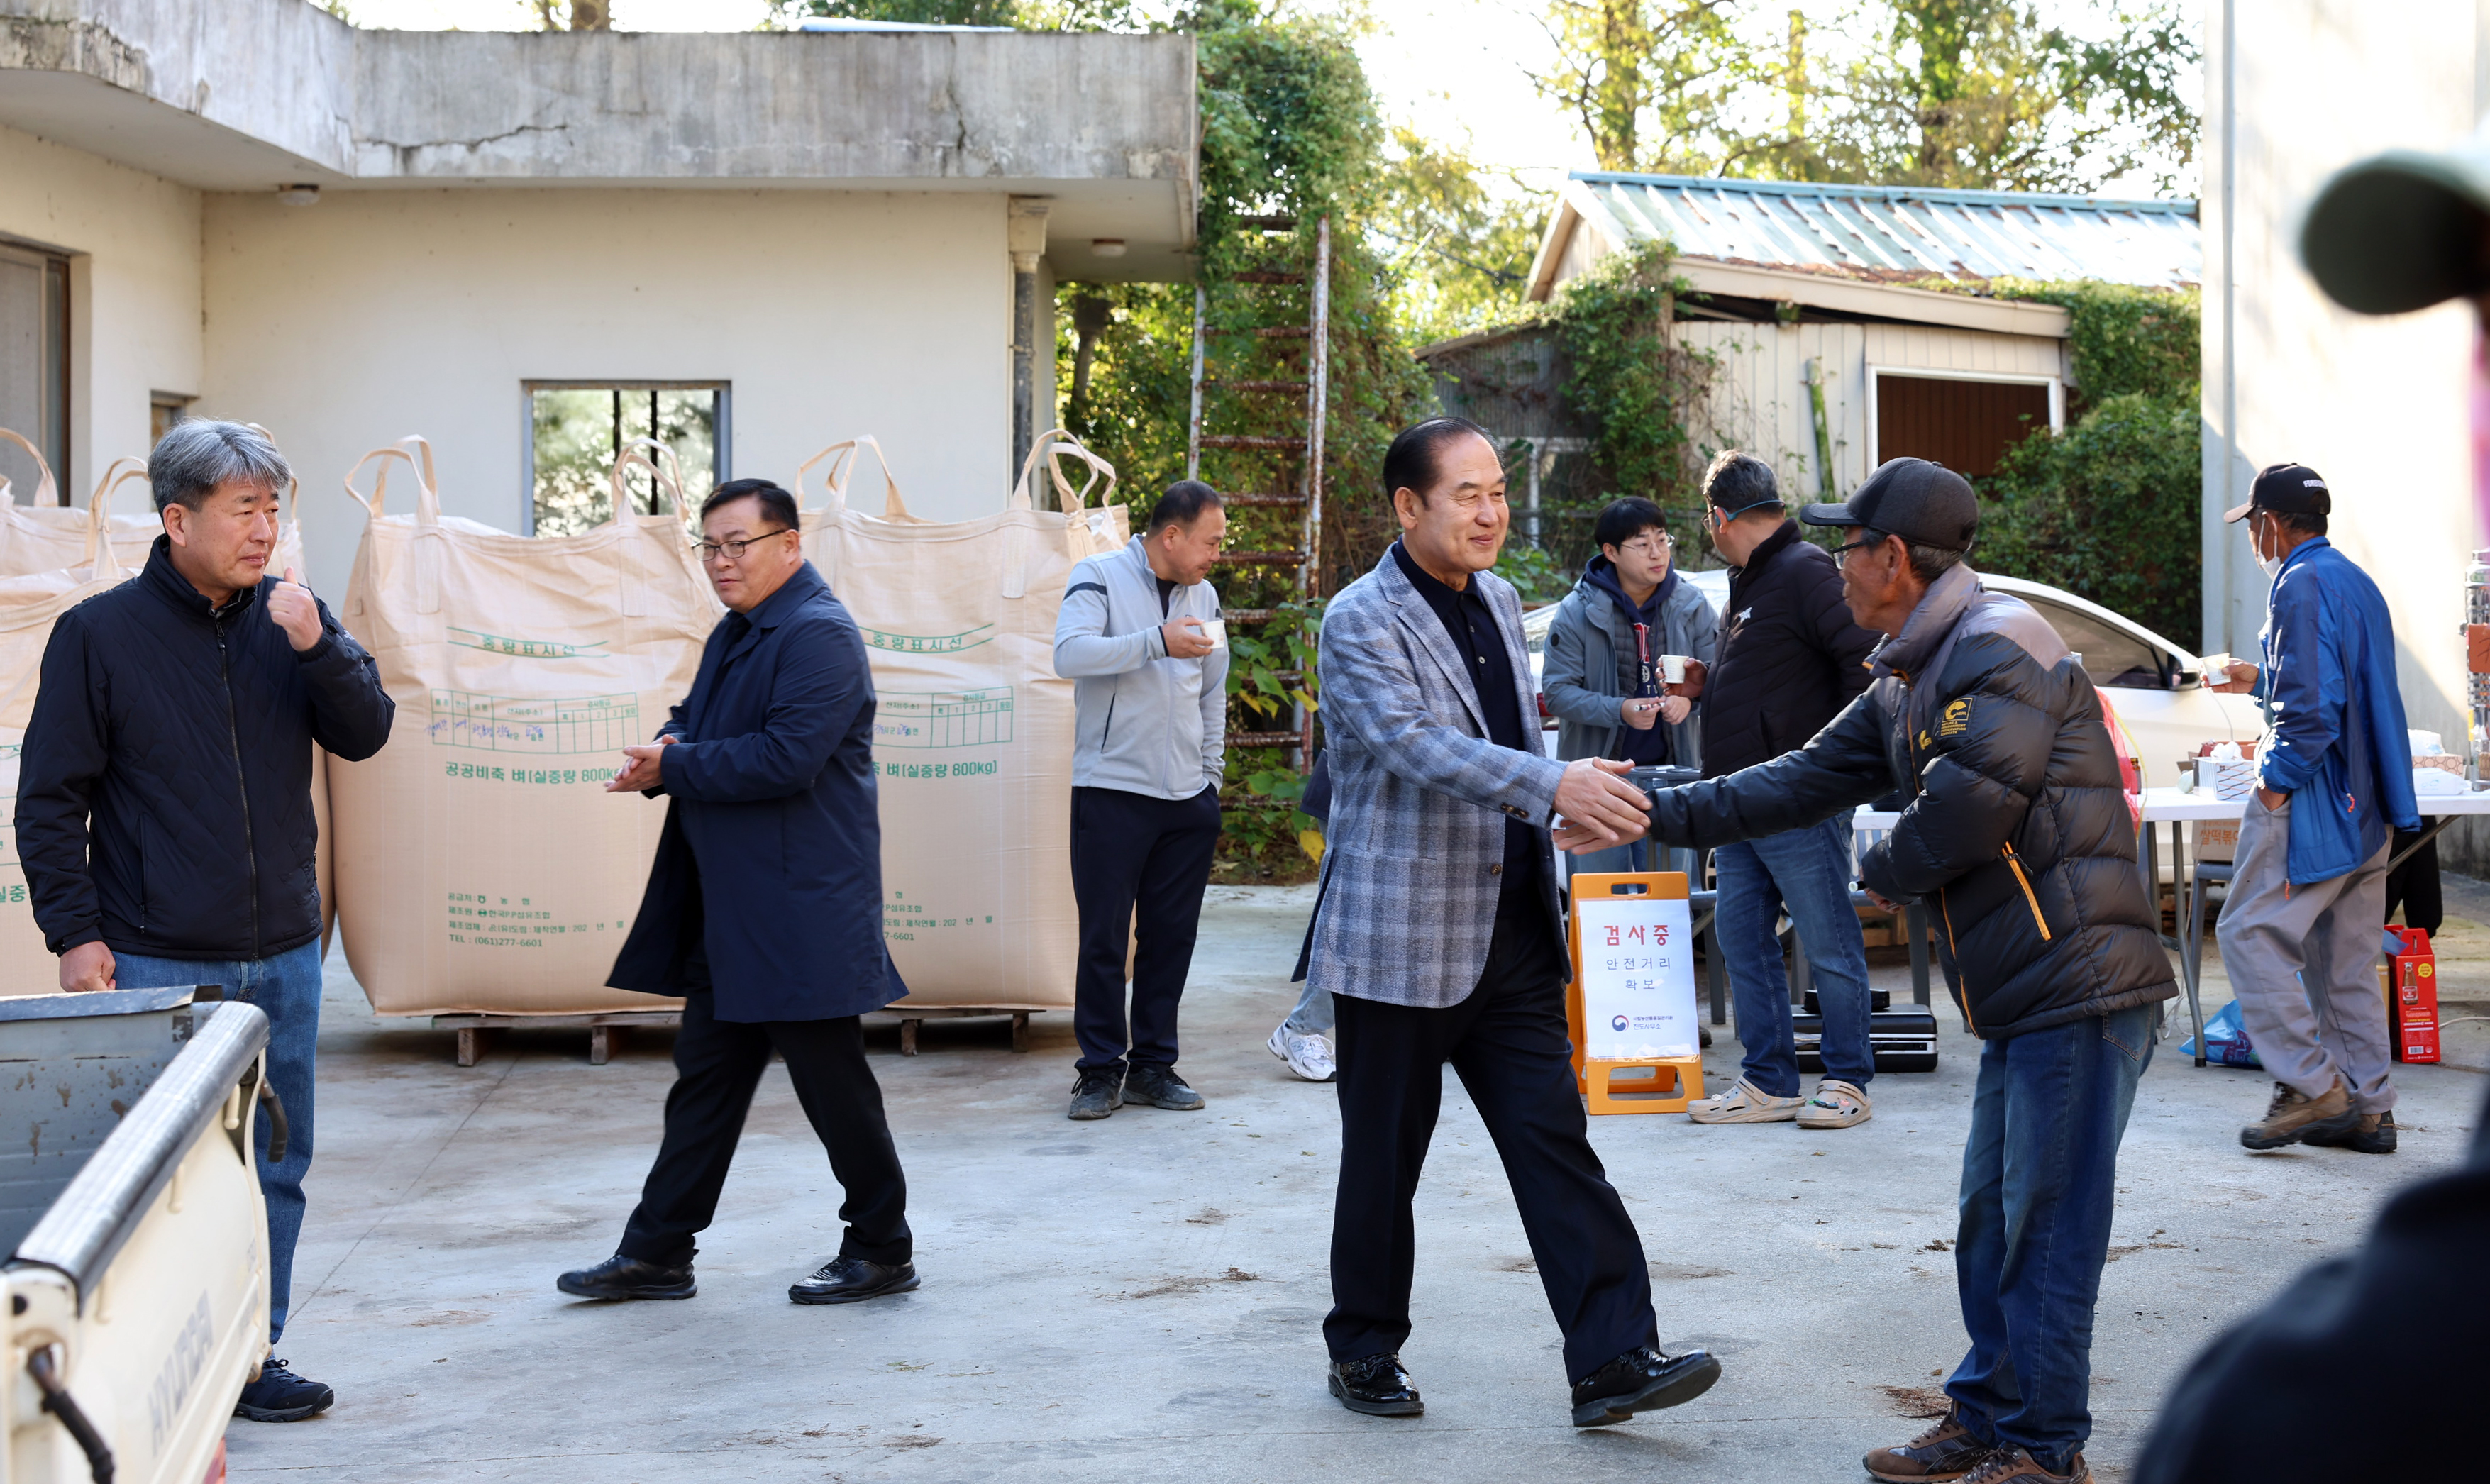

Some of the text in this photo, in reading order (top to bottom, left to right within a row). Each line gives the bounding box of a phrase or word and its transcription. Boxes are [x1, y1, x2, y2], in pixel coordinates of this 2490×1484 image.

[873, 632, 962, 650] 중량표시선
[446, 761, 504, 782] 공공비축
[512, 769, 525, 783] 벼
[887, 763, 900, 777] 벼
[450, 934, 465, 943] TEL
[475, 936, 543, 947] (061)277-6601
[1603, 924, 1669, 946] 검사중
[1606, 958, 1671, 970] 안전거리
[1625, 979, 1656, 991] 확보
